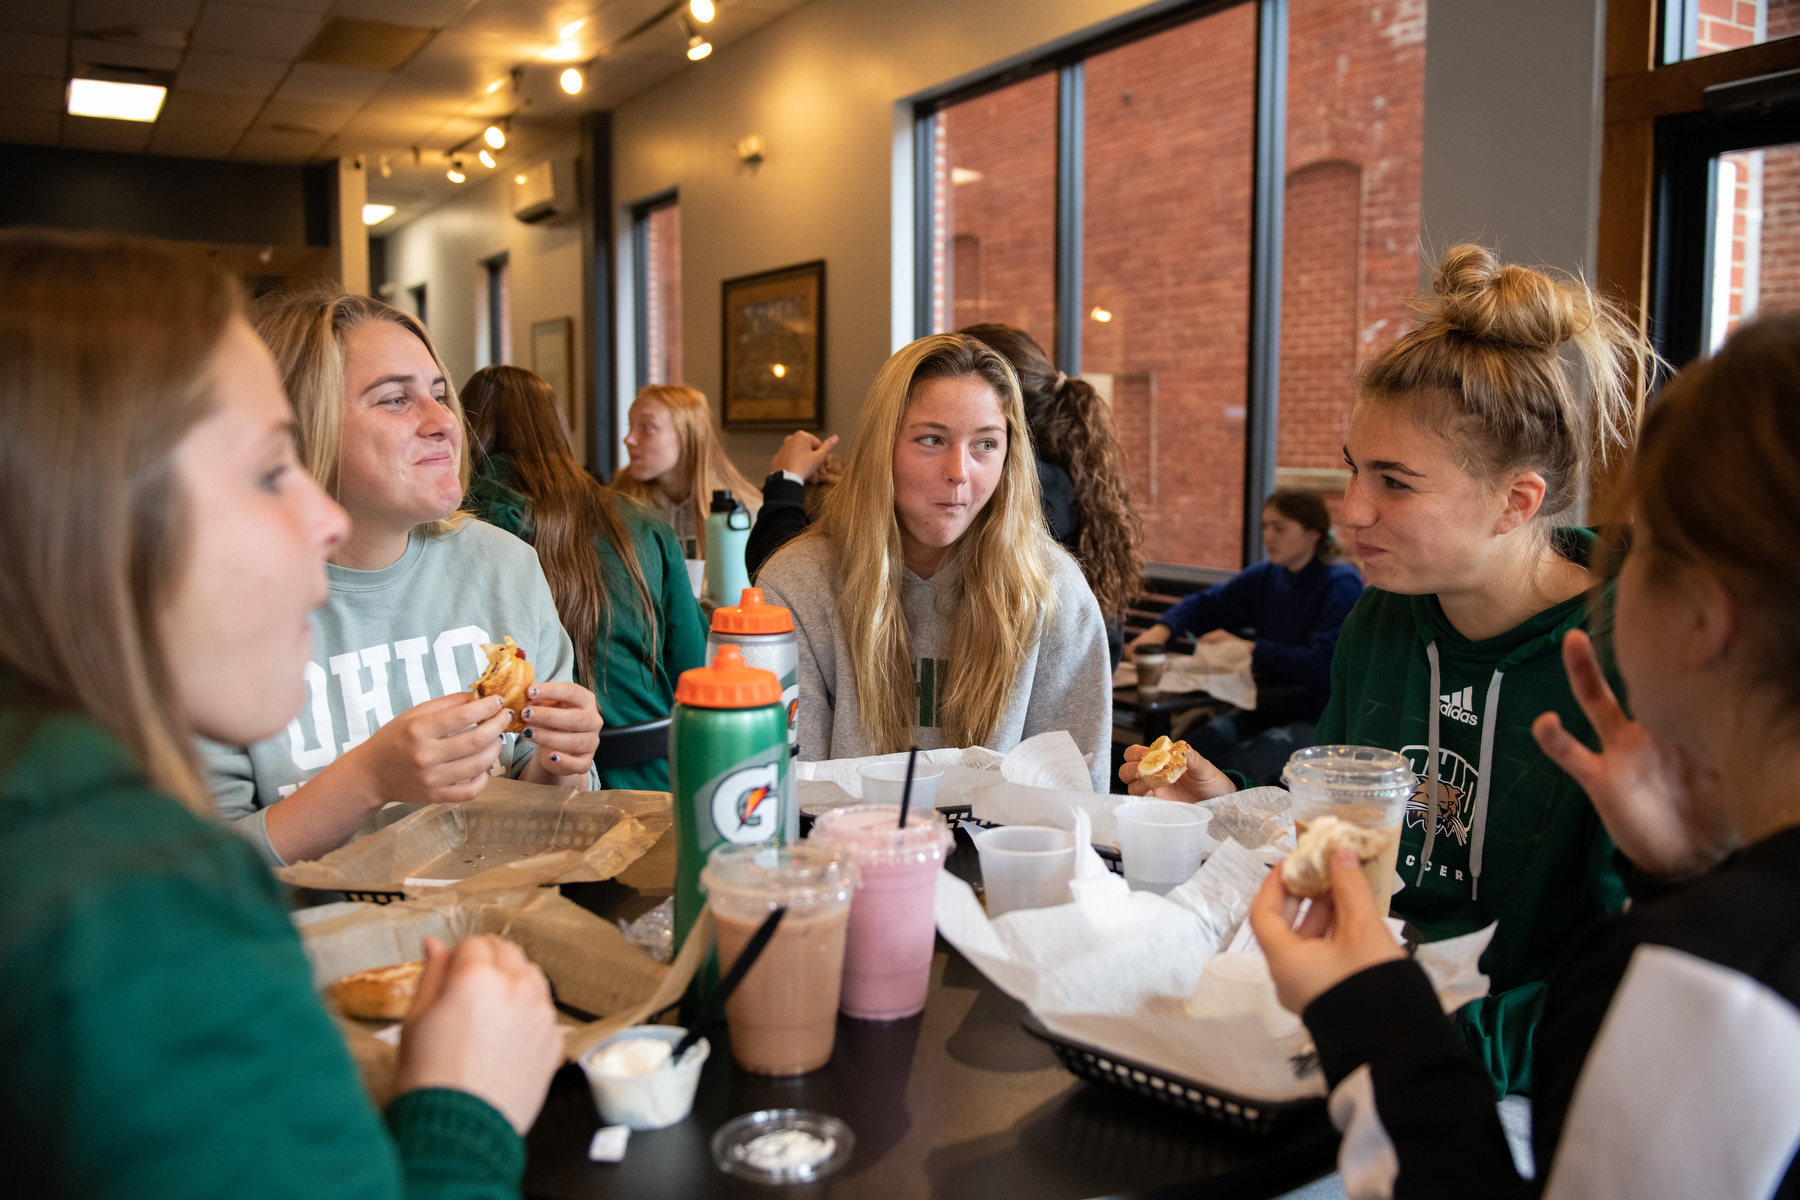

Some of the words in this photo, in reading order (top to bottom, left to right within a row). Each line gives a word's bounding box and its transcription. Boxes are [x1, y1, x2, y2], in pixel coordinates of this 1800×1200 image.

[1432, 701, 1478, 726] didas
[711, 761, 780, 845] G
[1404, 854, 1464, 881] CCER
